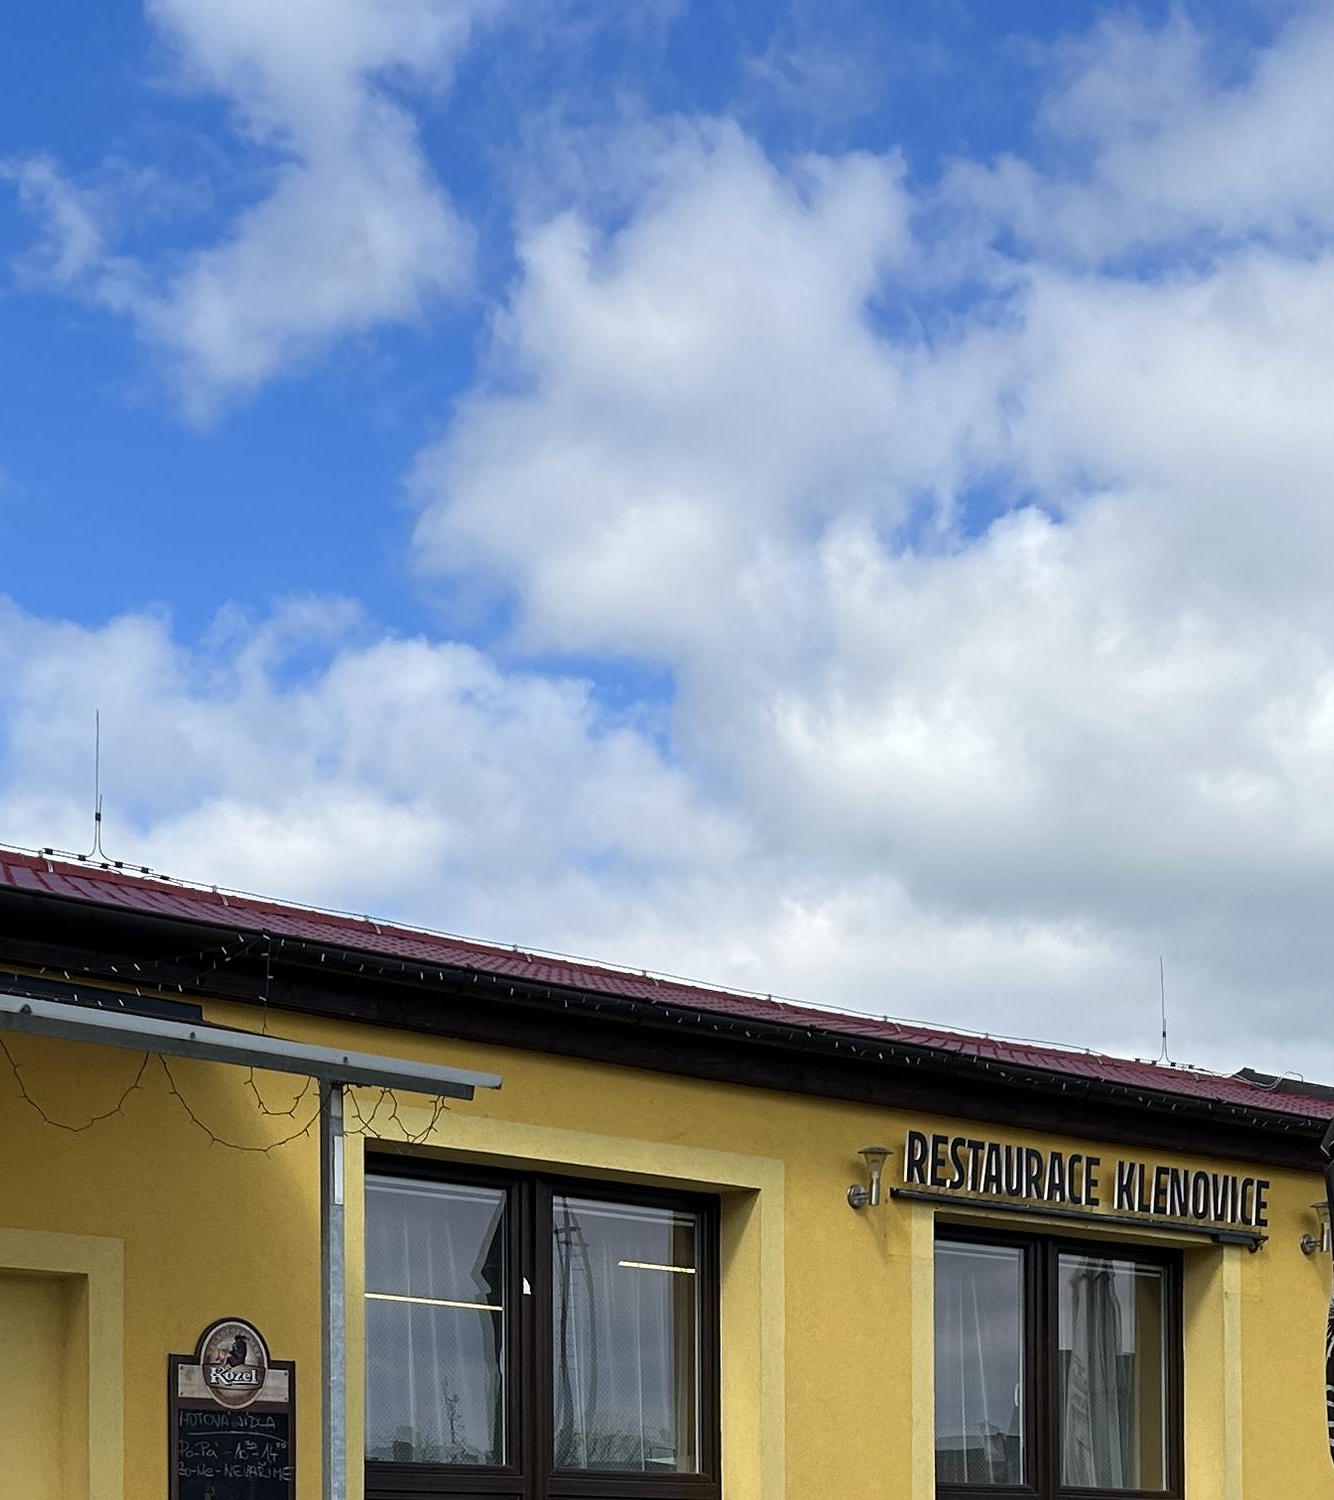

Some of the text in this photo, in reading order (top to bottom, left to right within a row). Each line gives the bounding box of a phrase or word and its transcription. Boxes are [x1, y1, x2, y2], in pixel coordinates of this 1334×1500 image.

[903, 1130, 1269, 1227] RESTAURACE KLENOVICE
[210, 1366, 258, 1386] Kozel
